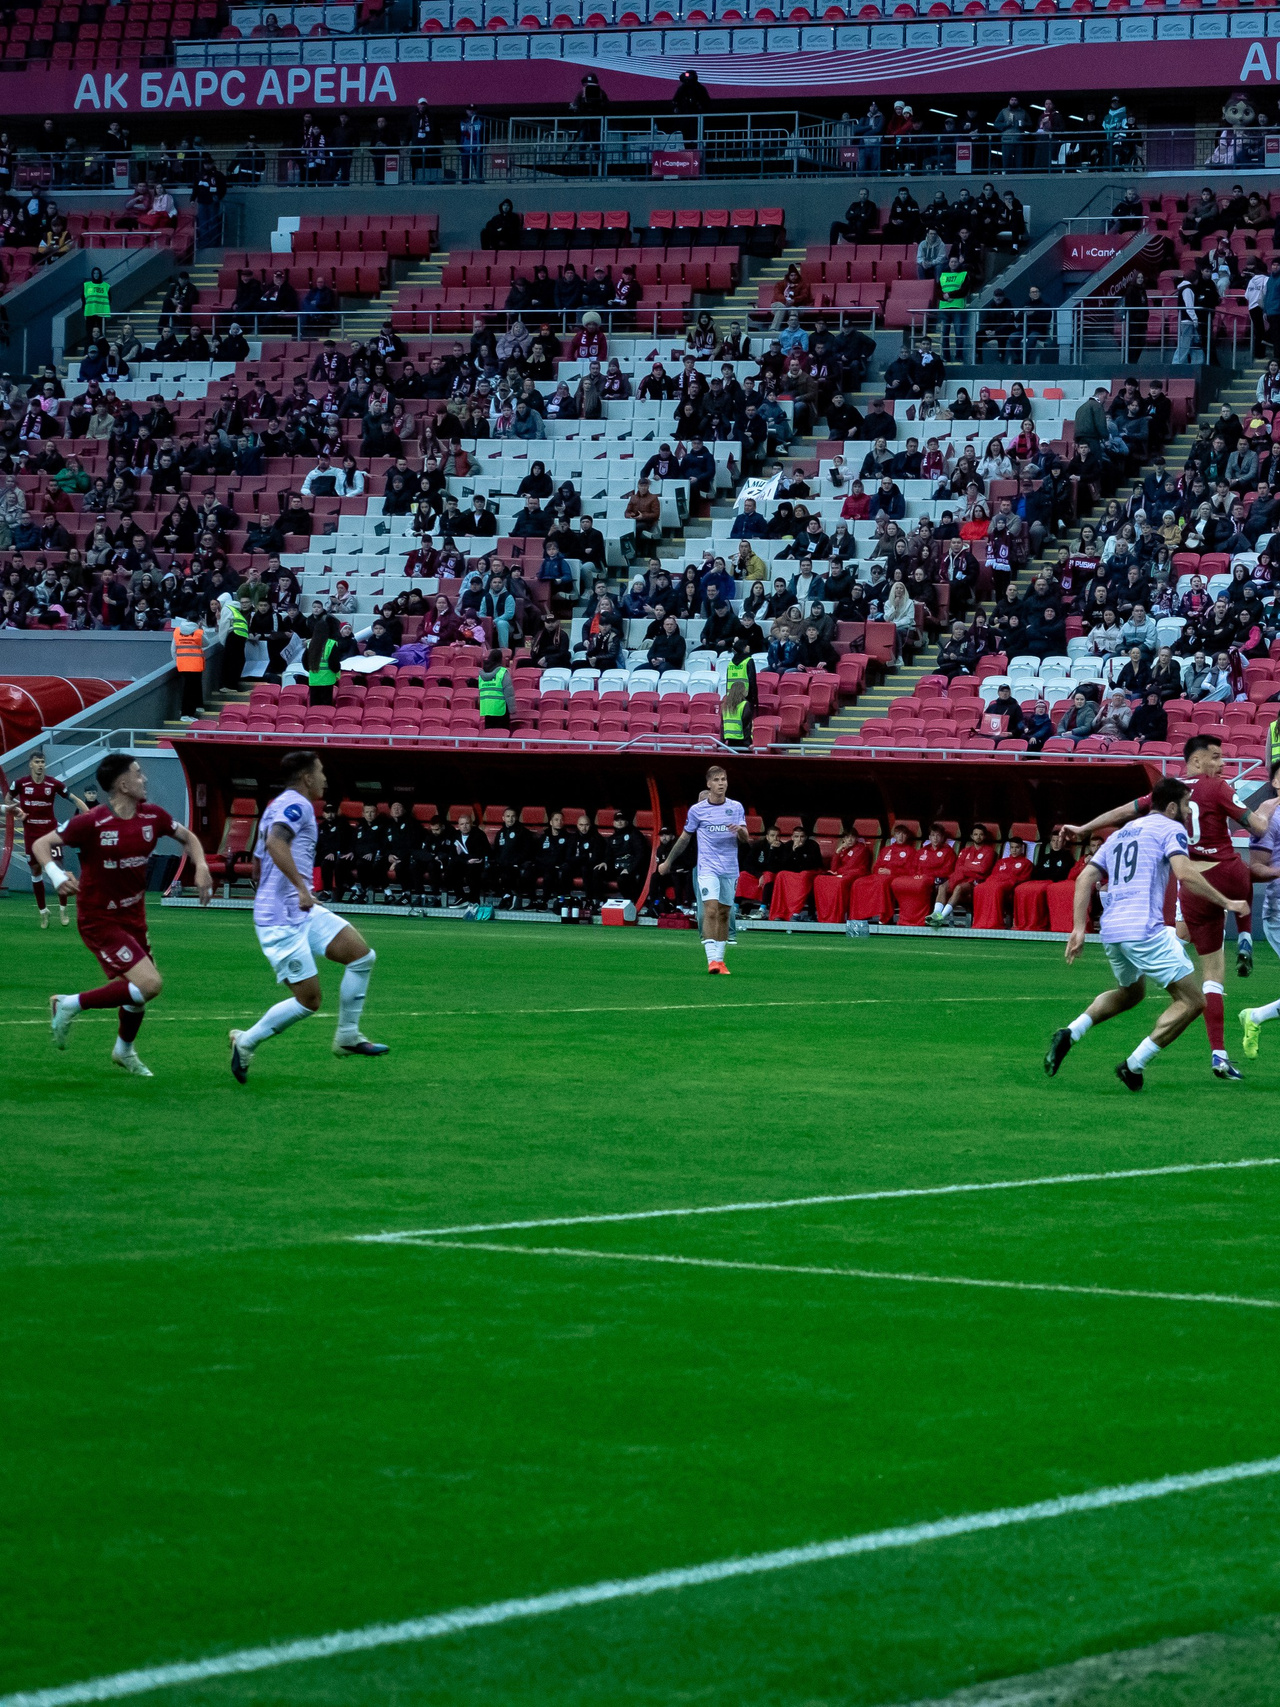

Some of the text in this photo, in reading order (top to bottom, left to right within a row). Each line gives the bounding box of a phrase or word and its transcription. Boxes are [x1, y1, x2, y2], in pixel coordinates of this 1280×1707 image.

[73, 65, 397, 109] АК БАРС АРЕНА
[100, 830, 119, 839] FON
[100, 838, 119, 846] BET
[1113, 840, 1138, 886] 19
